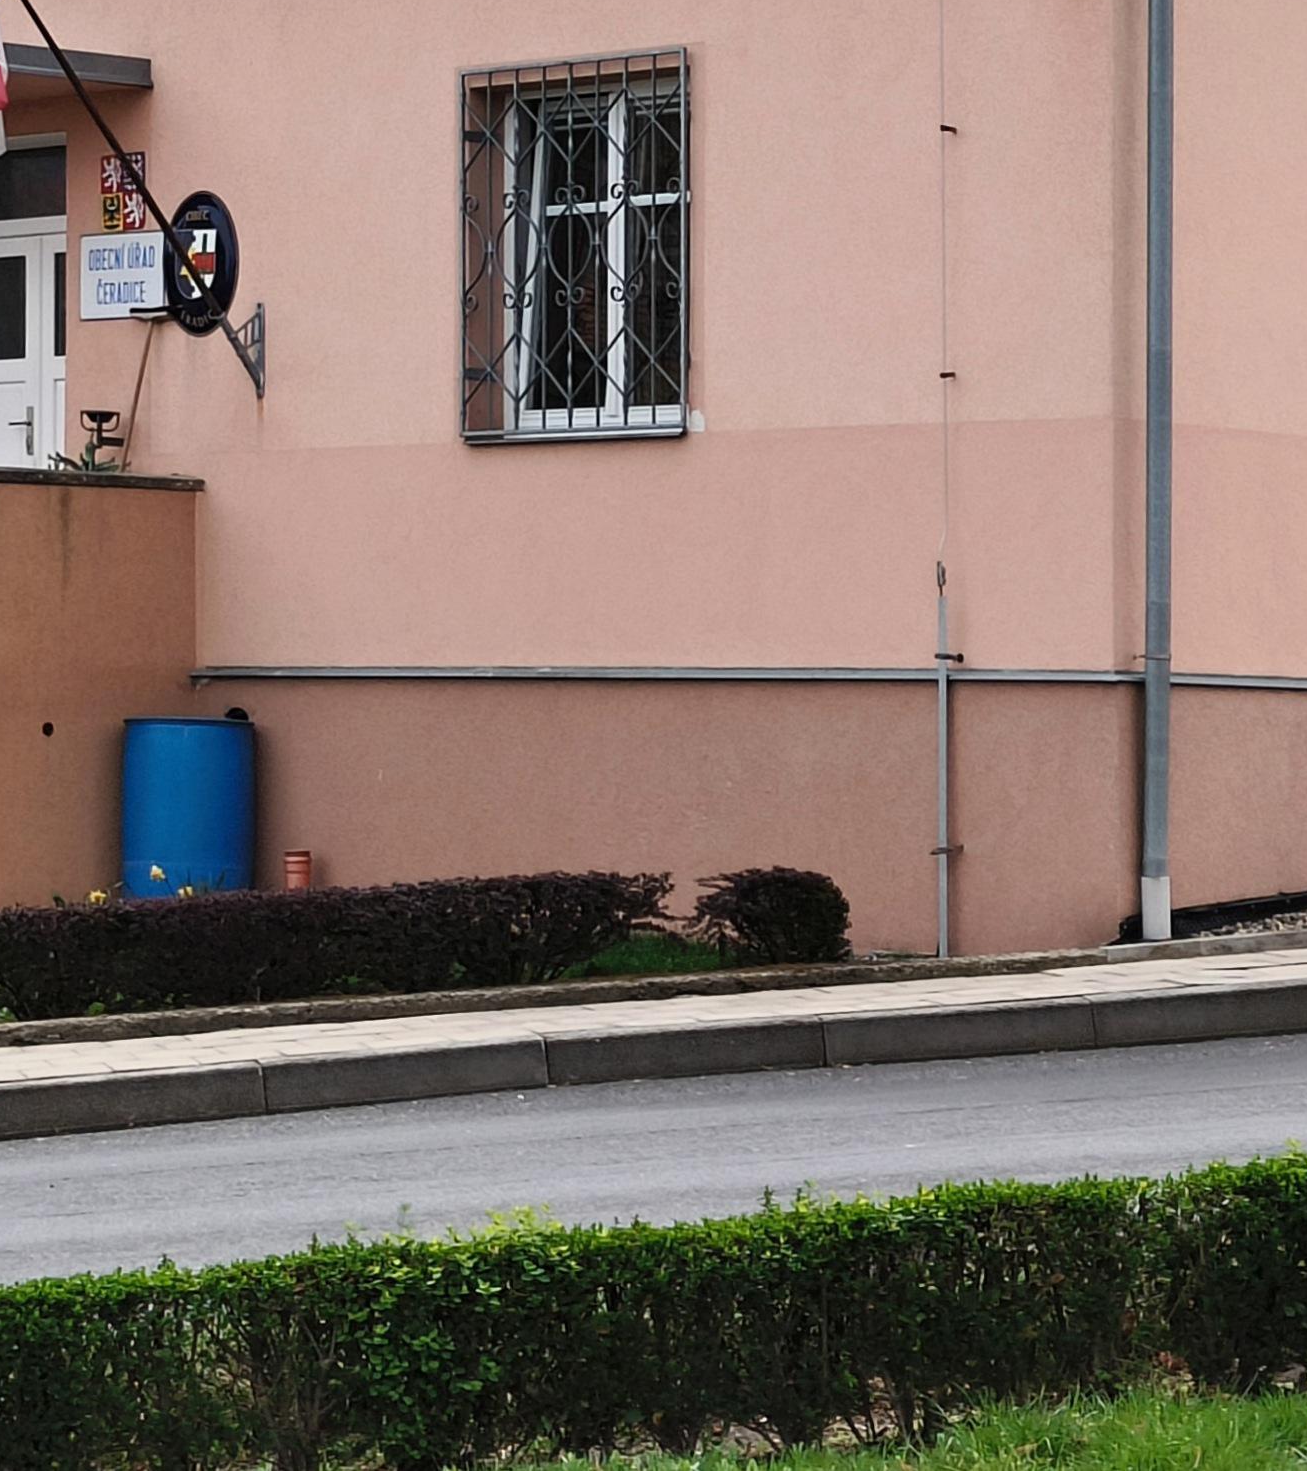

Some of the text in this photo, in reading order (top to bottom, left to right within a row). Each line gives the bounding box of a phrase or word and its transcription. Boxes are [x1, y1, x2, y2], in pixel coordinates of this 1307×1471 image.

[88, 242, 155, 271] OBECNÍ ÚŘAD
[97, 278, 146, 305] ČERADICE
